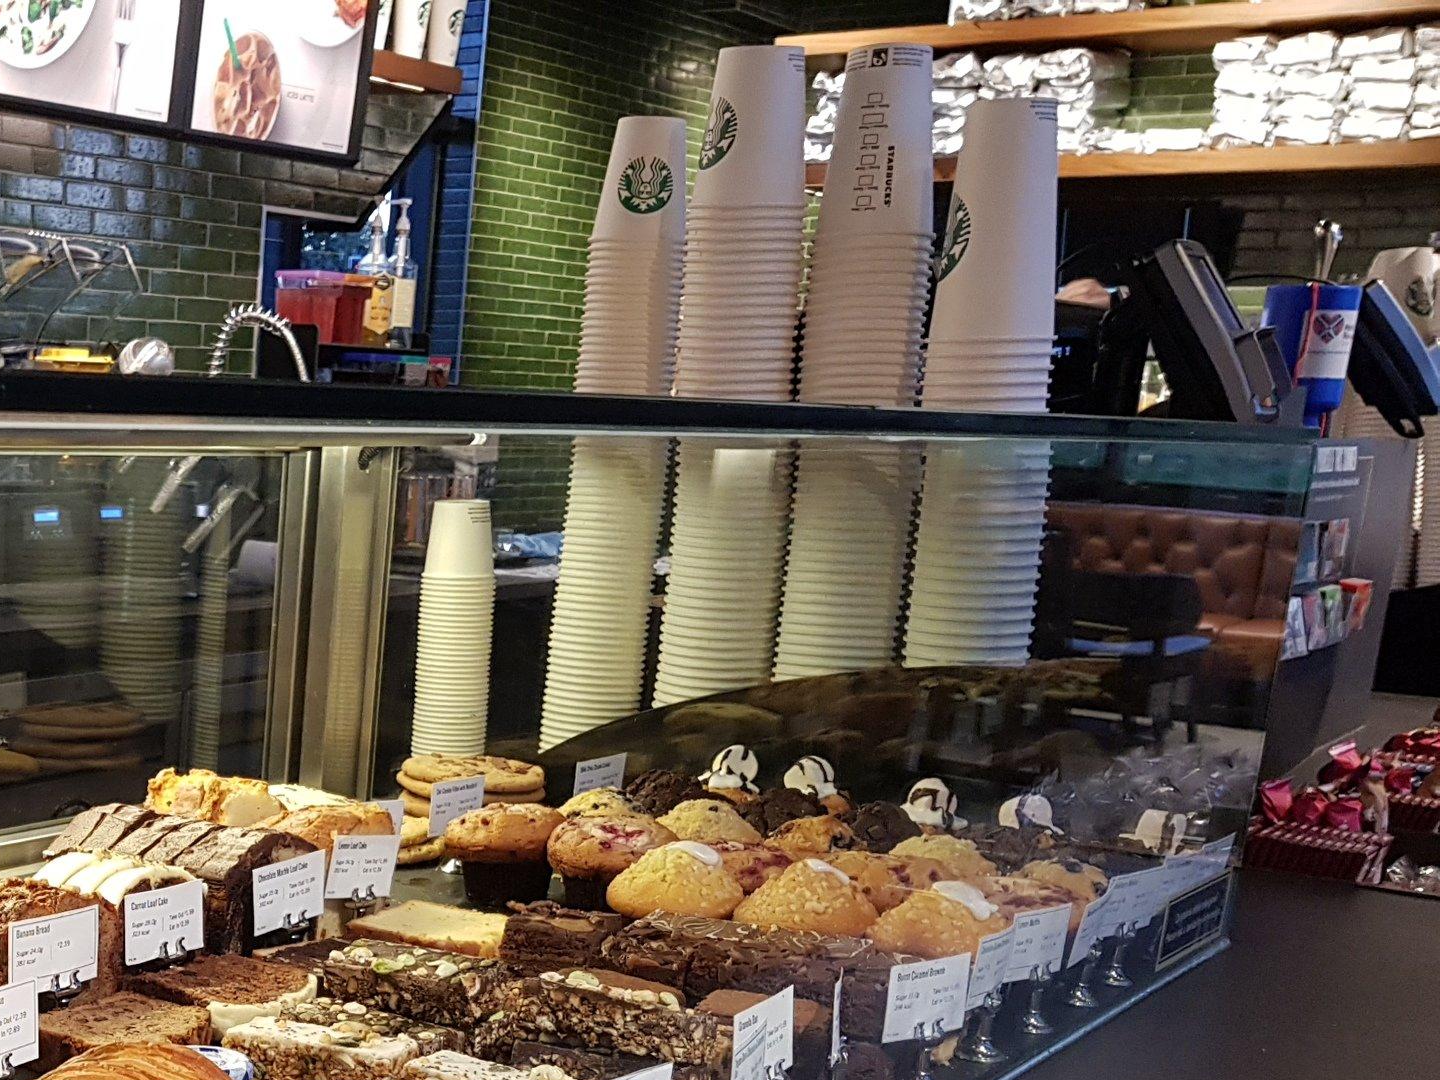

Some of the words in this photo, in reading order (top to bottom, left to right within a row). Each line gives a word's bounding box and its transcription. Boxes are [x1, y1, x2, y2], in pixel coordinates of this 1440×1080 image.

[883, 145, 895, 207] STARBUCKS
[158, 898, 168, 906] Cake
[16, 928, 34, 939] Banana
[35, 924, 50, 935] Bread
